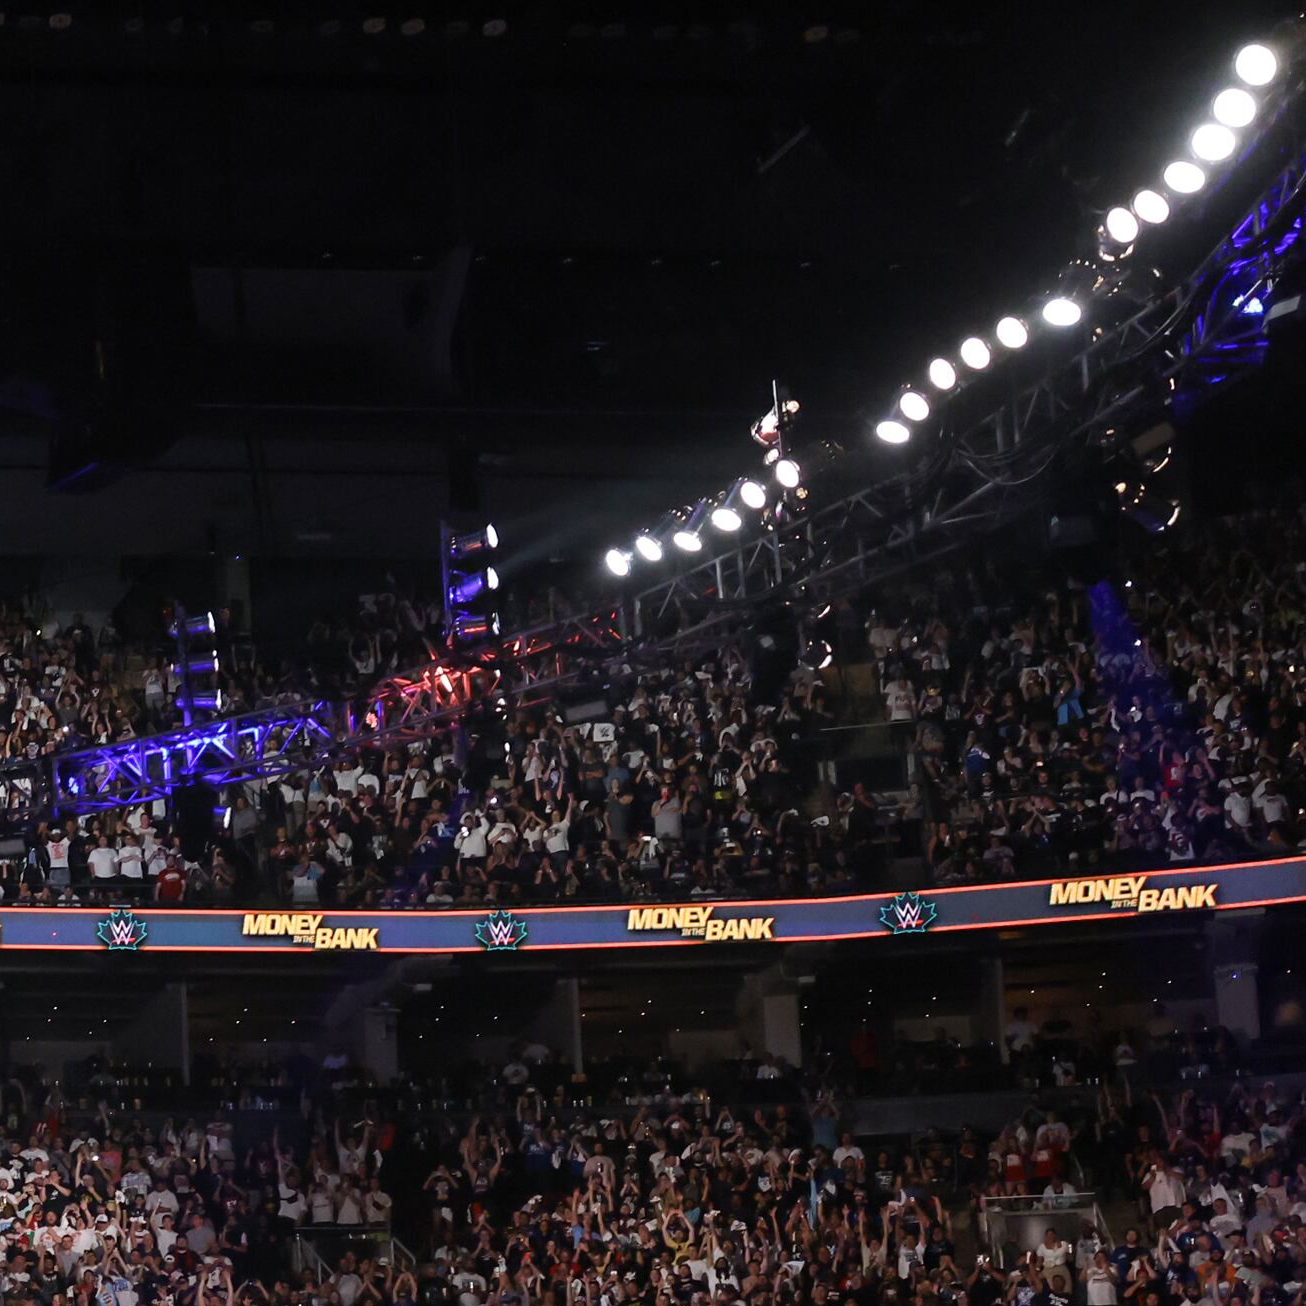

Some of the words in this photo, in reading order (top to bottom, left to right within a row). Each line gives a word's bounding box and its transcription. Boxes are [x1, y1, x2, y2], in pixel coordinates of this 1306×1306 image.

[1049, 876, 1146, 904] MONEY
[1137, 884, 1219, 912] BANK
[243, 914, 323, 935] MONEY
[315, 928, 379, 949] BANK
[628, 906, 714, 929] MONEY
[704, 918, 774, 940] BANK
